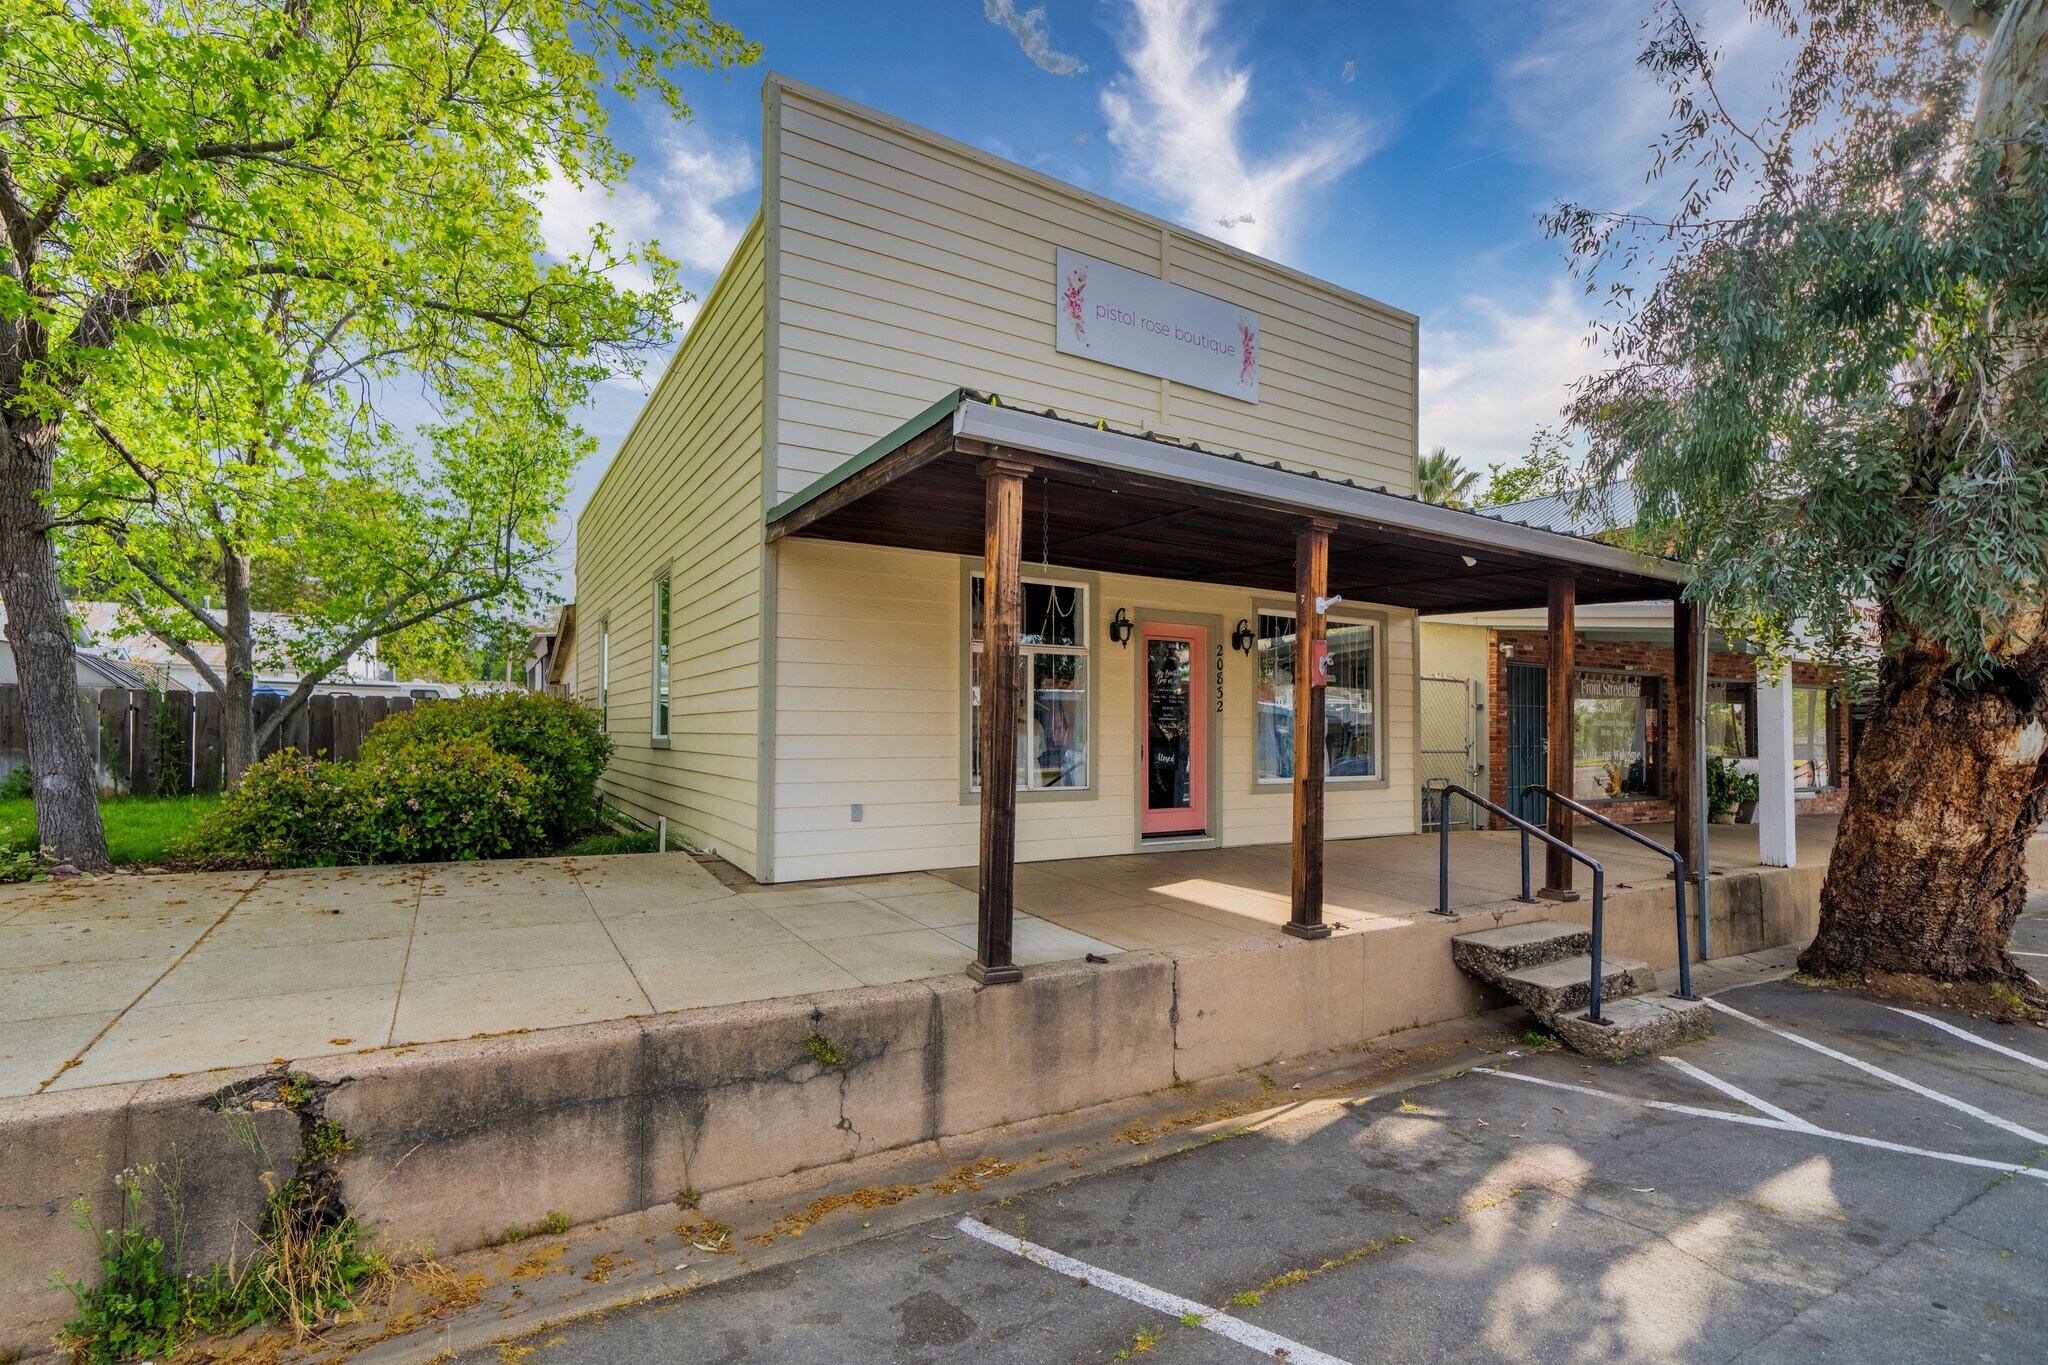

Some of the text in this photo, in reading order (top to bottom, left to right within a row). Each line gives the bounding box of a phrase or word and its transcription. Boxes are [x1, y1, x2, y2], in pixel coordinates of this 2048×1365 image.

[1096, 304, 1235, 357] pistol rose boutique
[1216, 644, 1224, 713] 20832
[1581, 680, 1641, 698] Front Street Hair
[1602, 699, 1622, 714] Salon
[1600, 729, 1611, 737] Mon
[1157, 752, 1176, 763] Closed
[1613, 749, 1641, 761] Welcome
